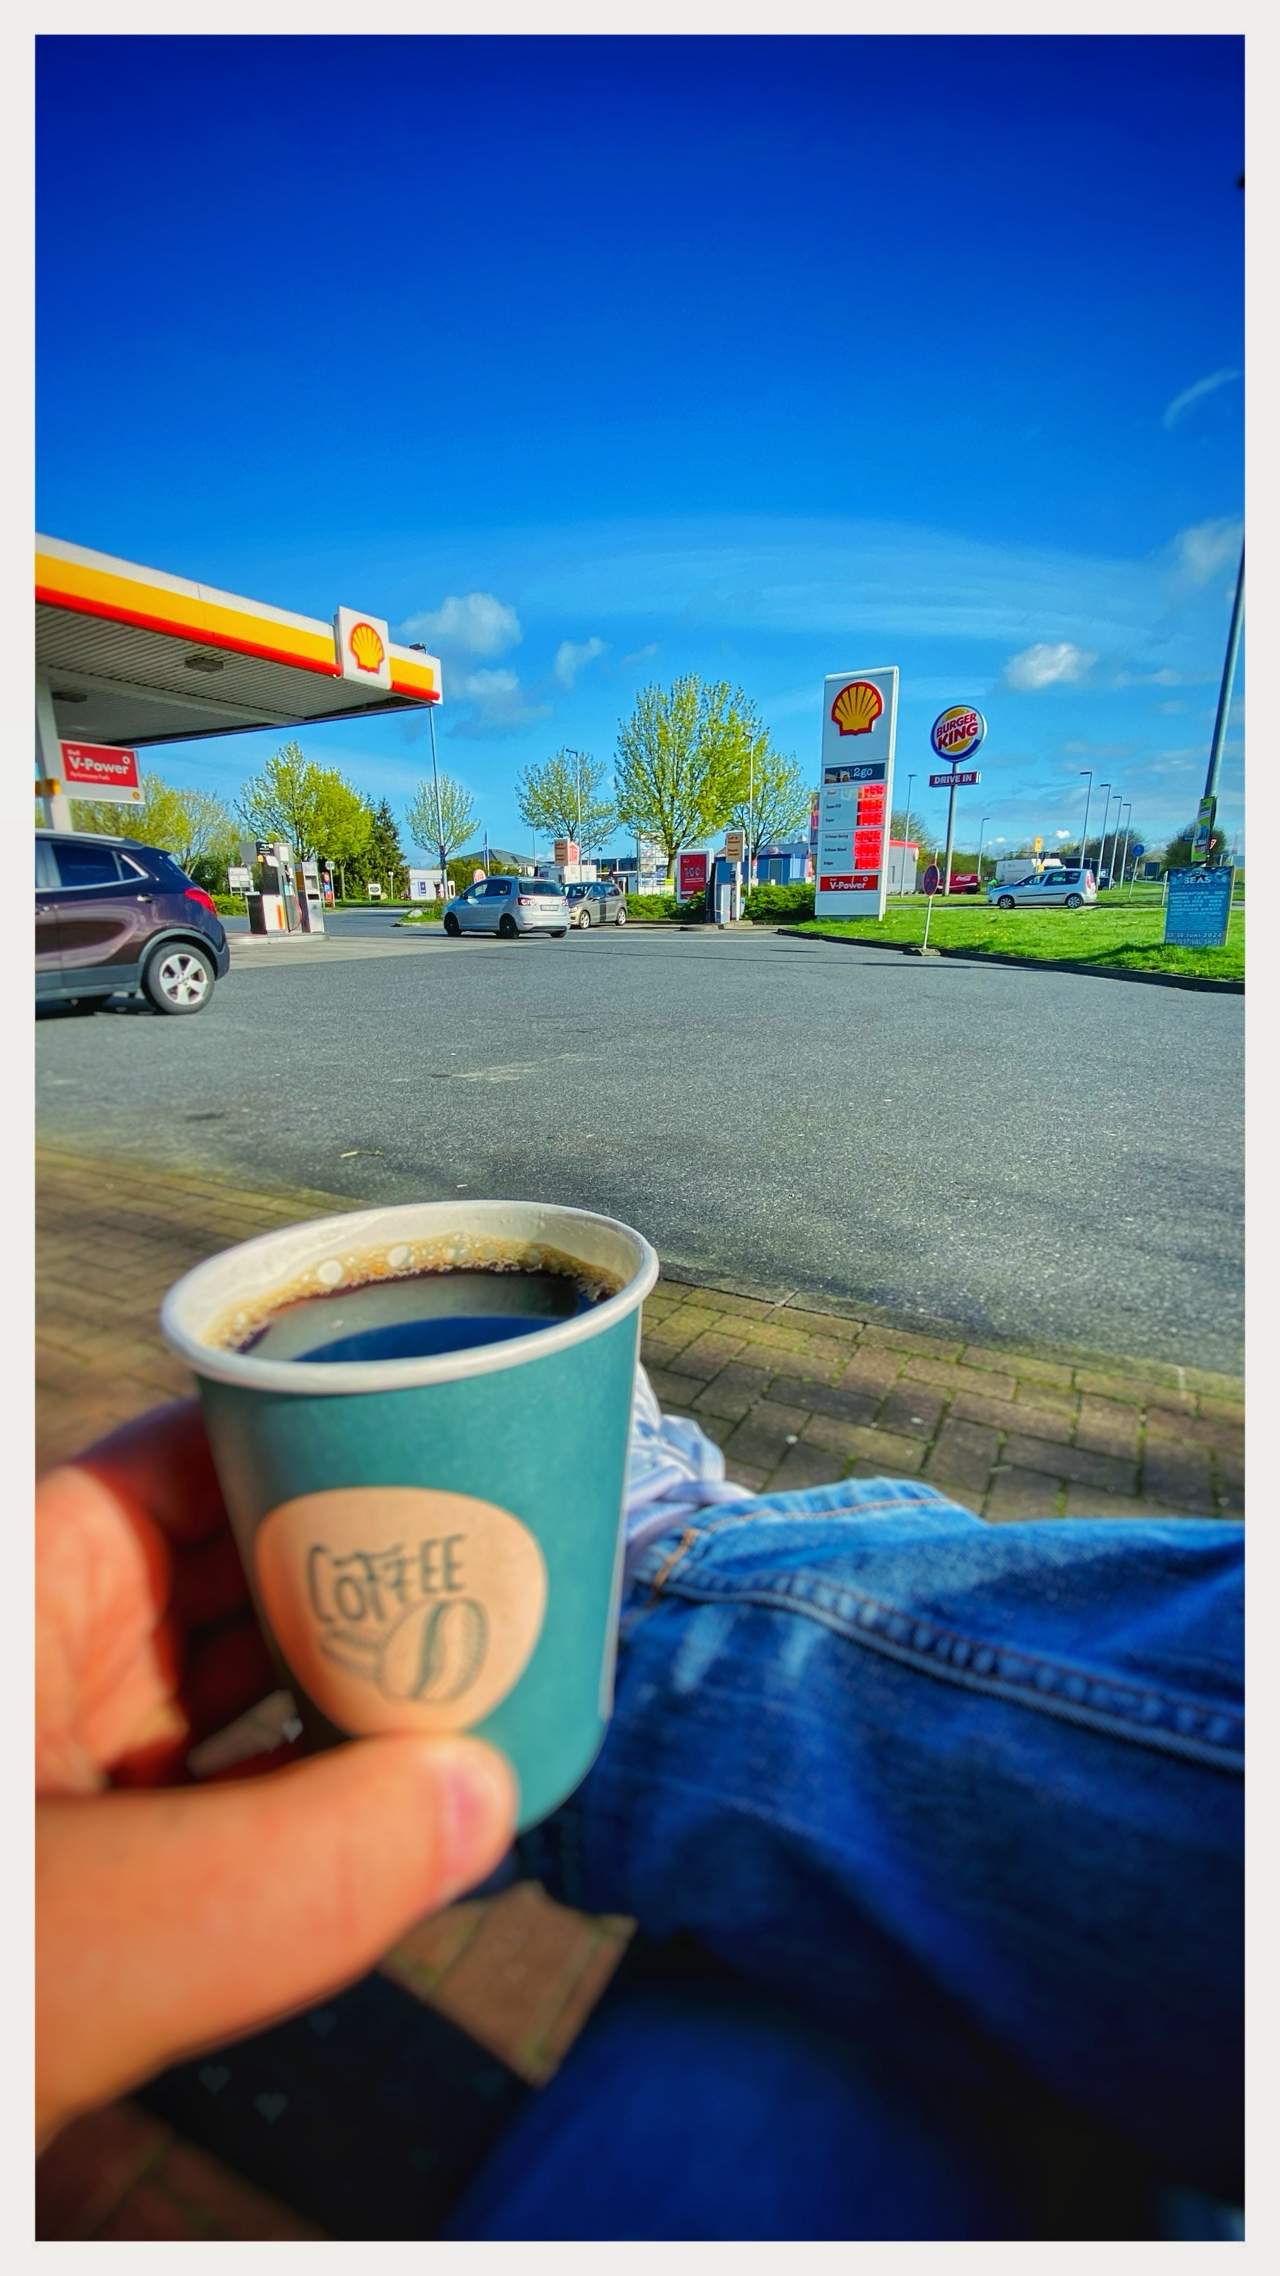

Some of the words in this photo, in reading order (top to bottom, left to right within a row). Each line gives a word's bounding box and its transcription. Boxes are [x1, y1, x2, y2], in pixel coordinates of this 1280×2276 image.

[936, 712, 977, 737] BURGER
[938, 722, 979, 750] KING
[68, 755, 129, 775] V-Power
[934, 775, 961, 784] DRIVE
[962, 773, 972, 781] IN
[829, 881, 867, 890] V-Power
